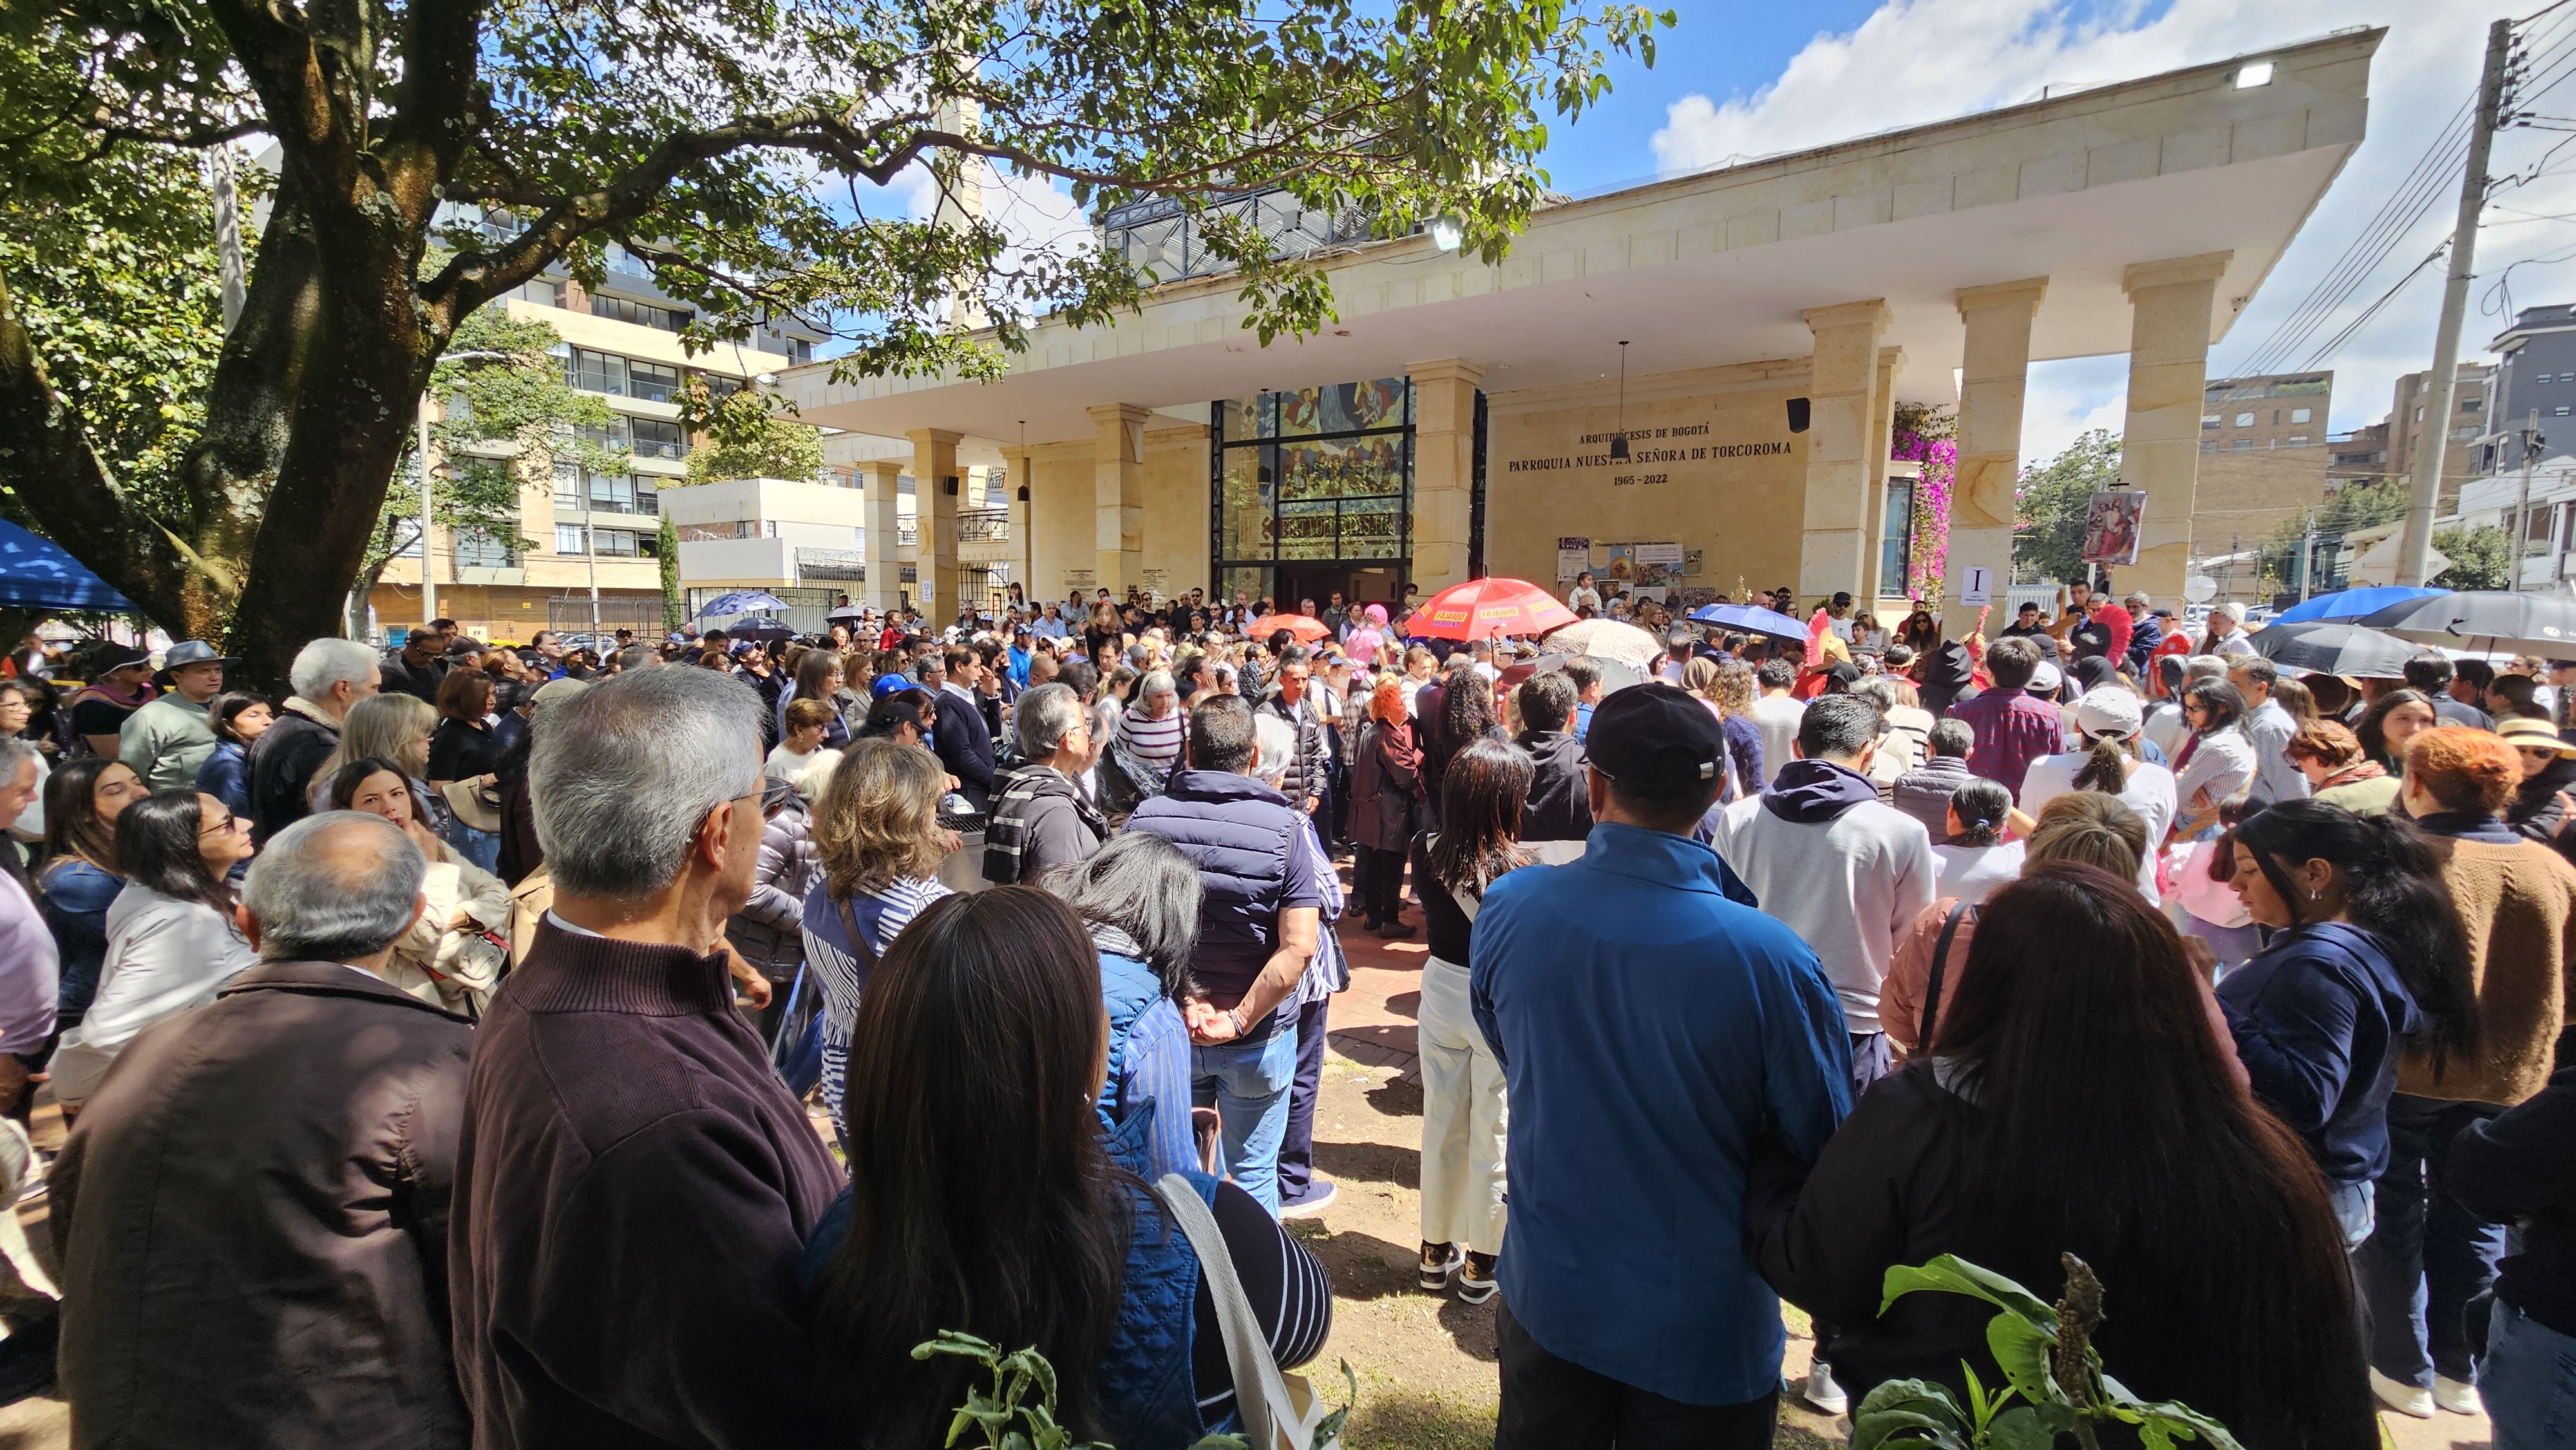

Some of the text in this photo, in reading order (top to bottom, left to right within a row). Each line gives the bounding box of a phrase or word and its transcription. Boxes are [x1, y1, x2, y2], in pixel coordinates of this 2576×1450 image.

[1656, 428, 1667, 438] DE
[1672, 422, 1709, 437] BOGOTÁ
[1509, 442, 1792, 472] PARROQUIA NUESTA SEÑORA DE TORCOROMA
[1971, 570, 1984, 592] I
[1435, 612, 1465, 620] FAJARDO
[1482, 608, 1516, 617] FAJARDO
